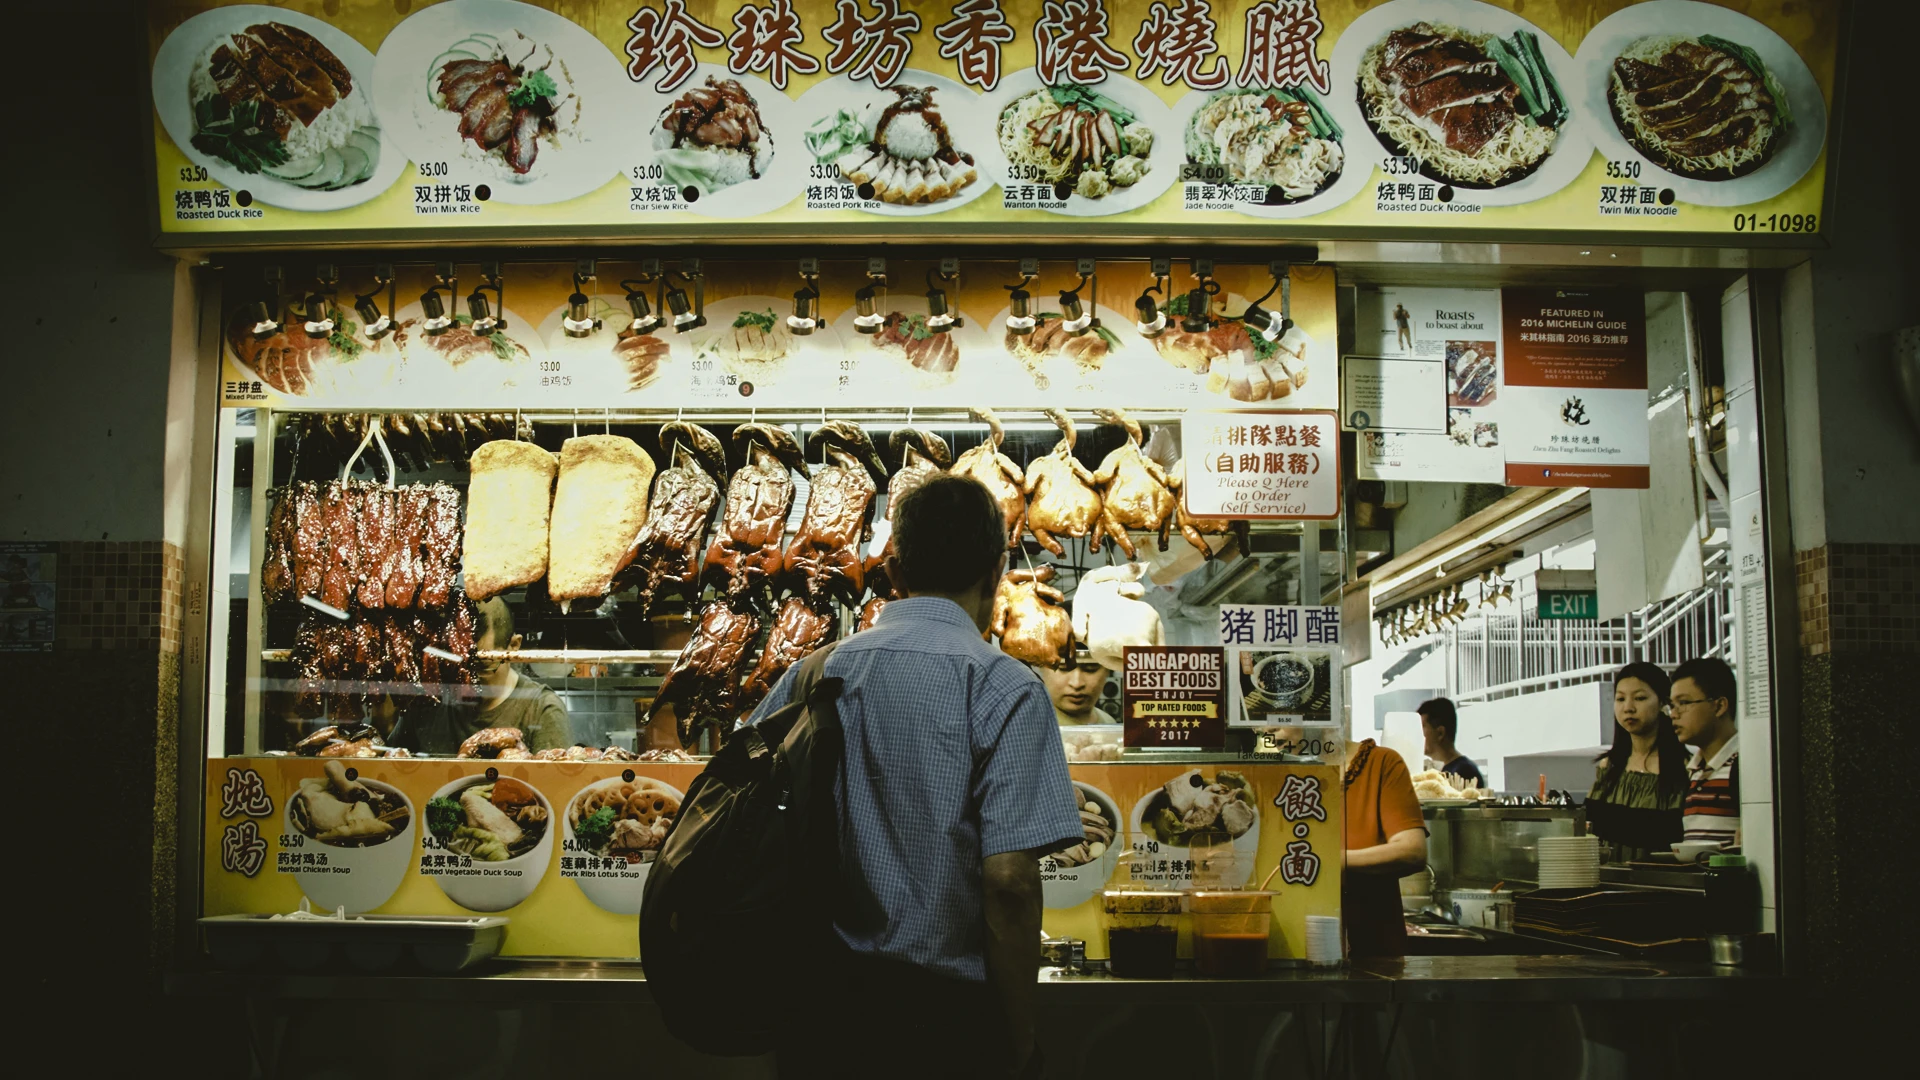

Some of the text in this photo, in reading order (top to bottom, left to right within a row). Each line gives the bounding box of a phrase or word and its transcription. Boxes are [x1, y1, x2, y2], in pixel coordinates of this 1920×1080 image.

[420, 162, 448, 177] $5.00
[634, 165, 662, 180] $3.00
[810, 164, 840, 179] $3.00
[1008, 165, 1038, 180] $3.50
[1383, 157, 1418, 175] $3.50
[1607, 161, 1640, 179] $5.50
[180, 166, 207, 182] $3.50
[1183, 167, 1224, 180] $4.00
[415, 184, 471, 204] 双拼饭
[630, 186, 677, 202] 叉烧饭
[807, 184, 855, 201] 烧肉饭
[1004, 185, 1051, 201] 云吞面
[1185, 186, 1265, 201] 翡翠水饺面
[1377, 183, 1434, 202] 烧鸭面
[1600, 187, 1657, 204] 双拼面
[176, 190, 230, 209] 烧鸭饭
[807, 201, 881, 209] Roasted Pork Rice
[1004, 200, 1067, 209] Wanton Noodle
[1185, 202, 1234, 210] Jade Noodle
[416, 203, 480, 213] Twin Mix Rice
[630, 203, 650, 211] Char
[652, 203, 671, 211] Siew
[1377, 203, 1481, 213] Roasted Duck Noodle
[1599, 206, 1678, 216] Twin Mix Noodle
[176, 208, 263, 220] Roasted Duck Rice
[1734, 214, 1816, 233] 01-1098
[1435, 309, 1475, 321] Roasts
[1540, 309, 1604, 318] FEATURED IN
[1426, 321, 1484, 330] to boast about
[1521, 319, 1627, 330] 2016 MICHELIN GUIDE
[1520, 332, 1629, 345] 米其林指南 2016 强力推荐
[539, 361, 561, 371] $3.00
[692, 361, 713, 371] $3.00
[225, 381, 263, 393] 三拼盘
[539, 376, 572, 387] 油鸡饭
[691, 375, 737, 386] 海鸡饭
[742, 384, 750, 395] 9
[1597, 446, 1621, 454] Delights
[1218, 477, 1309, 490] Please Q Here
[1235, 490, 1291, 501] to Order
[1221, 502, 1306, 515] (Self Service)
[1550, 594, 1589, 615] EXIT
[1221, 606, 1340, 645] 猪脚醋
[1127, 652, 1220, 671] SINGAPORE
[1129, 672, 1217, 688] BEST FOODS
[1154, 691, 1193, 700] ENJOY
[1141, 703, 1207, 712] TOP RATED FOODS
[1160, 730, 1190, 741] 2017
[279, 834, 304, 848] $5.50
[422, 836, 448, 850] $4.50
[562, 839, 589, 852] $4.00
[277, 852, 328, 866] 药材鸡汤
[421, 855, 472, 868] 咸菜鸭汤
[445, 868, 482, 876] Vegetable
[620, 871, 640, 879] Soup
